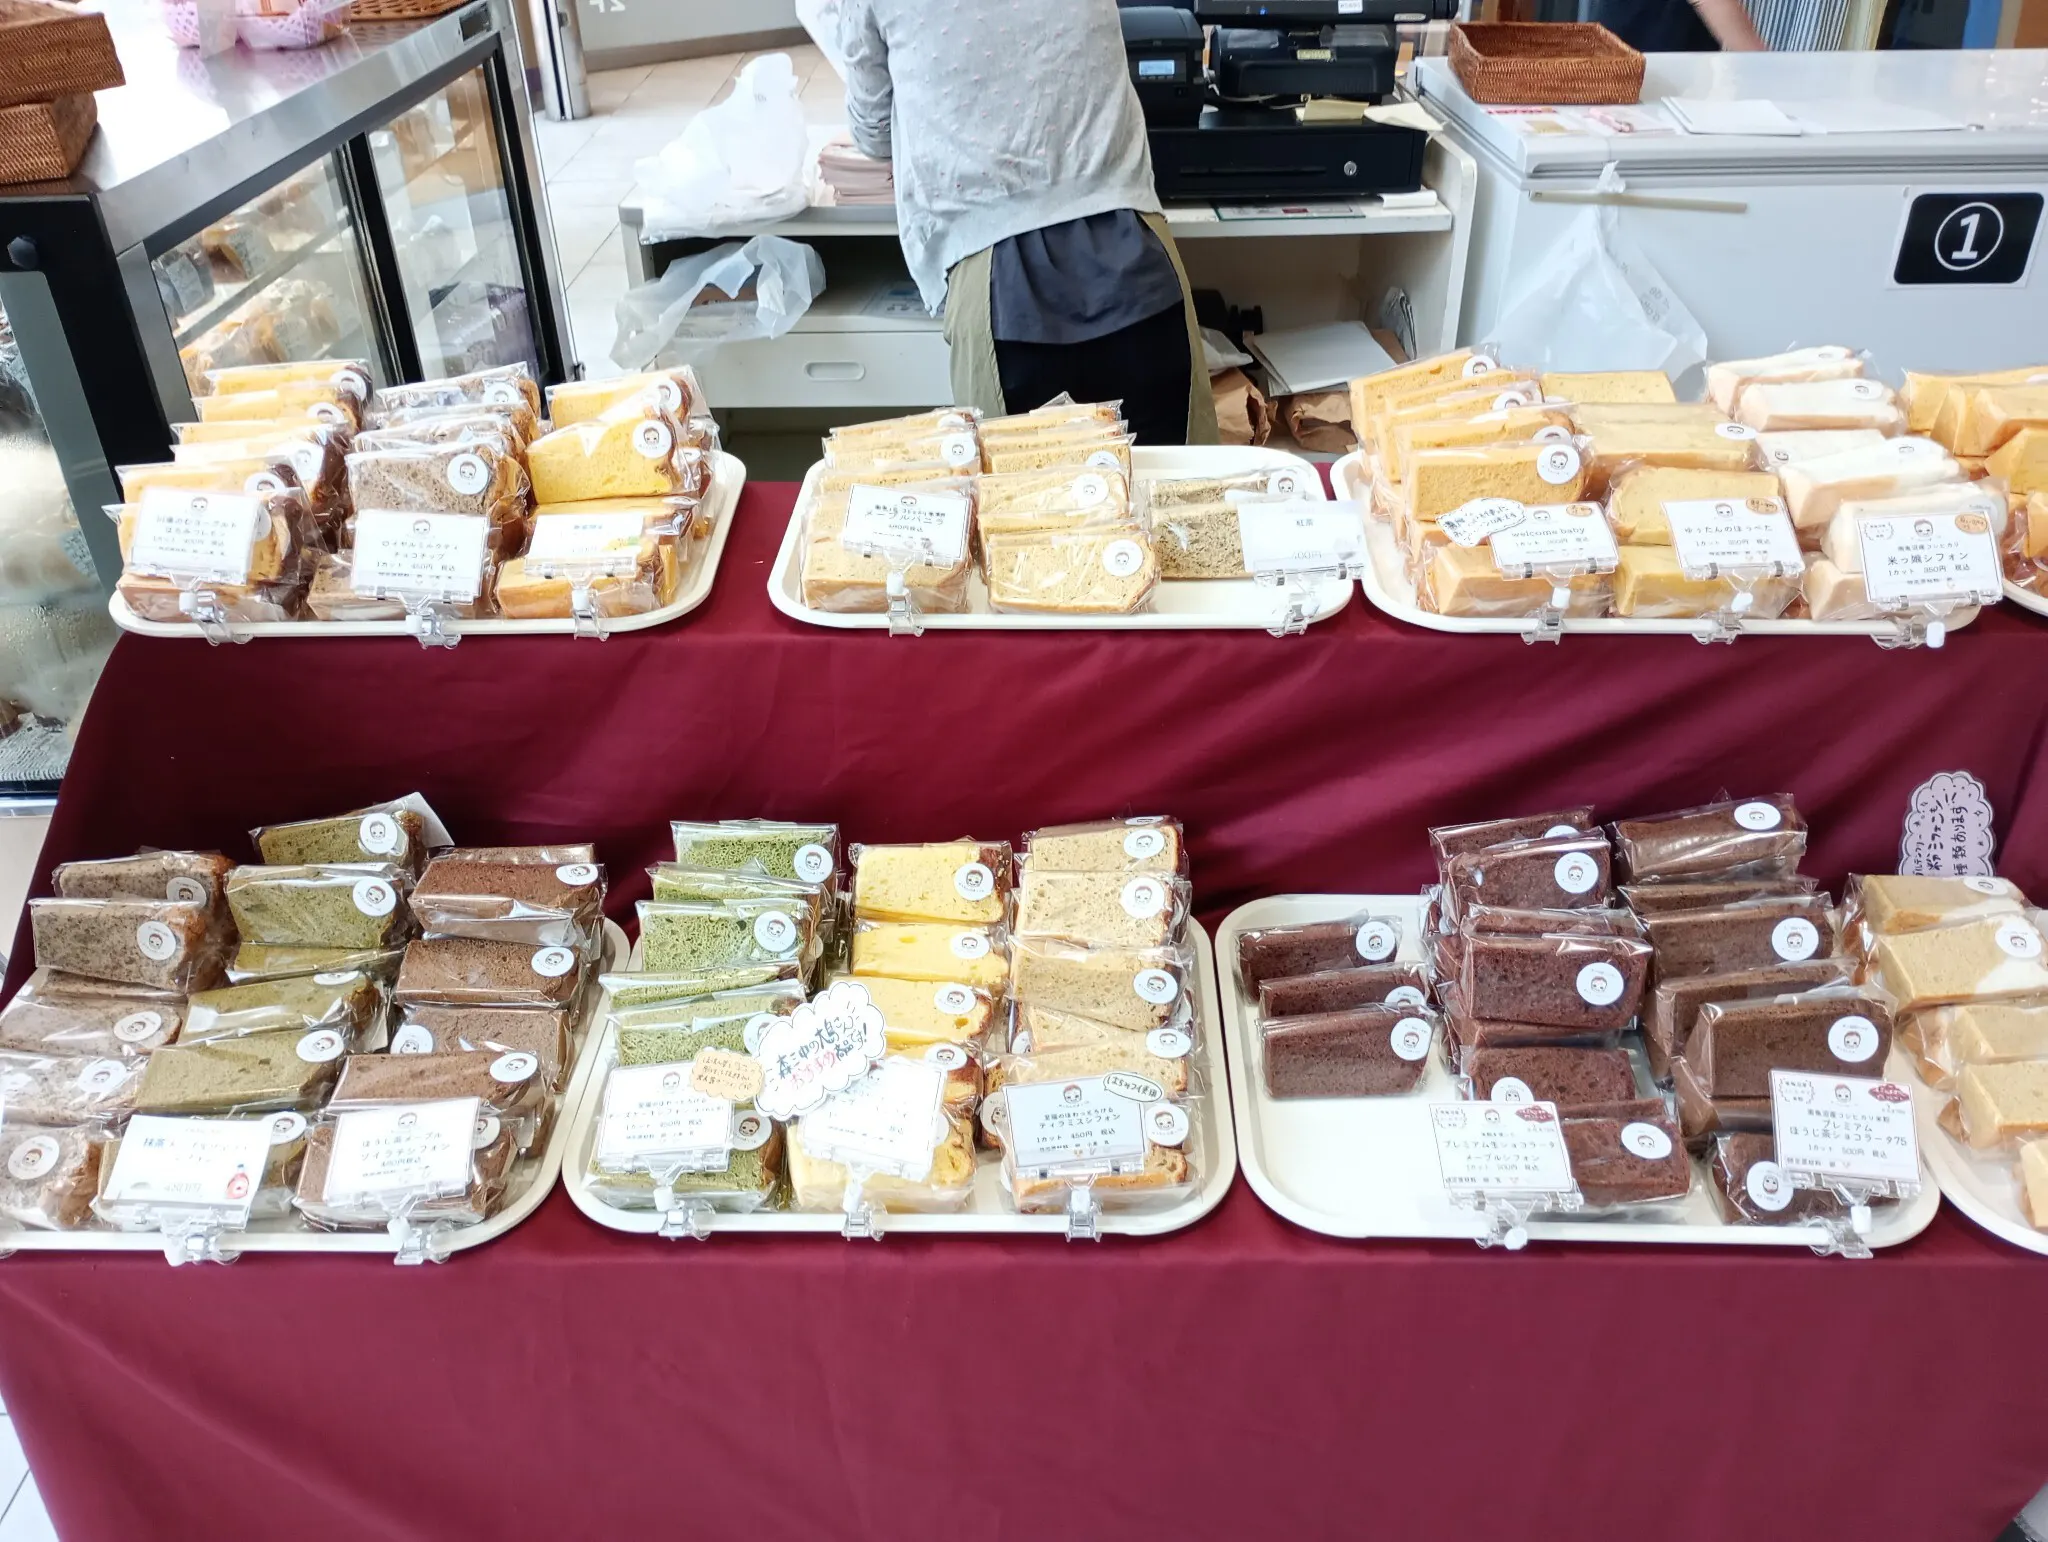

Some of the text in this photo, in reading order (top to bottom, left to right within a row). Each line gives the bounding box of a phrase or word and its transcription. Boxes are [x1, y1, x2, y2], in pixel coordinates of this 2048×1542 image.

[864, 509, 945, 527] メープルバニラ
[1511, 527, 1586, 538] welcome baby
[1888, 563, 1971, 577] 1カット 350円 税込
[1039, 1113, 1121, 1130] ティラミスシフォン
[1822, 1119, 1873, 1132] プレミアム
[1036, 1134, 1063, 1143] 1カット
[1100, 1128, 1116, 1136] 税込
[1466, 1152, 1540, 1162] メープルシフォン
